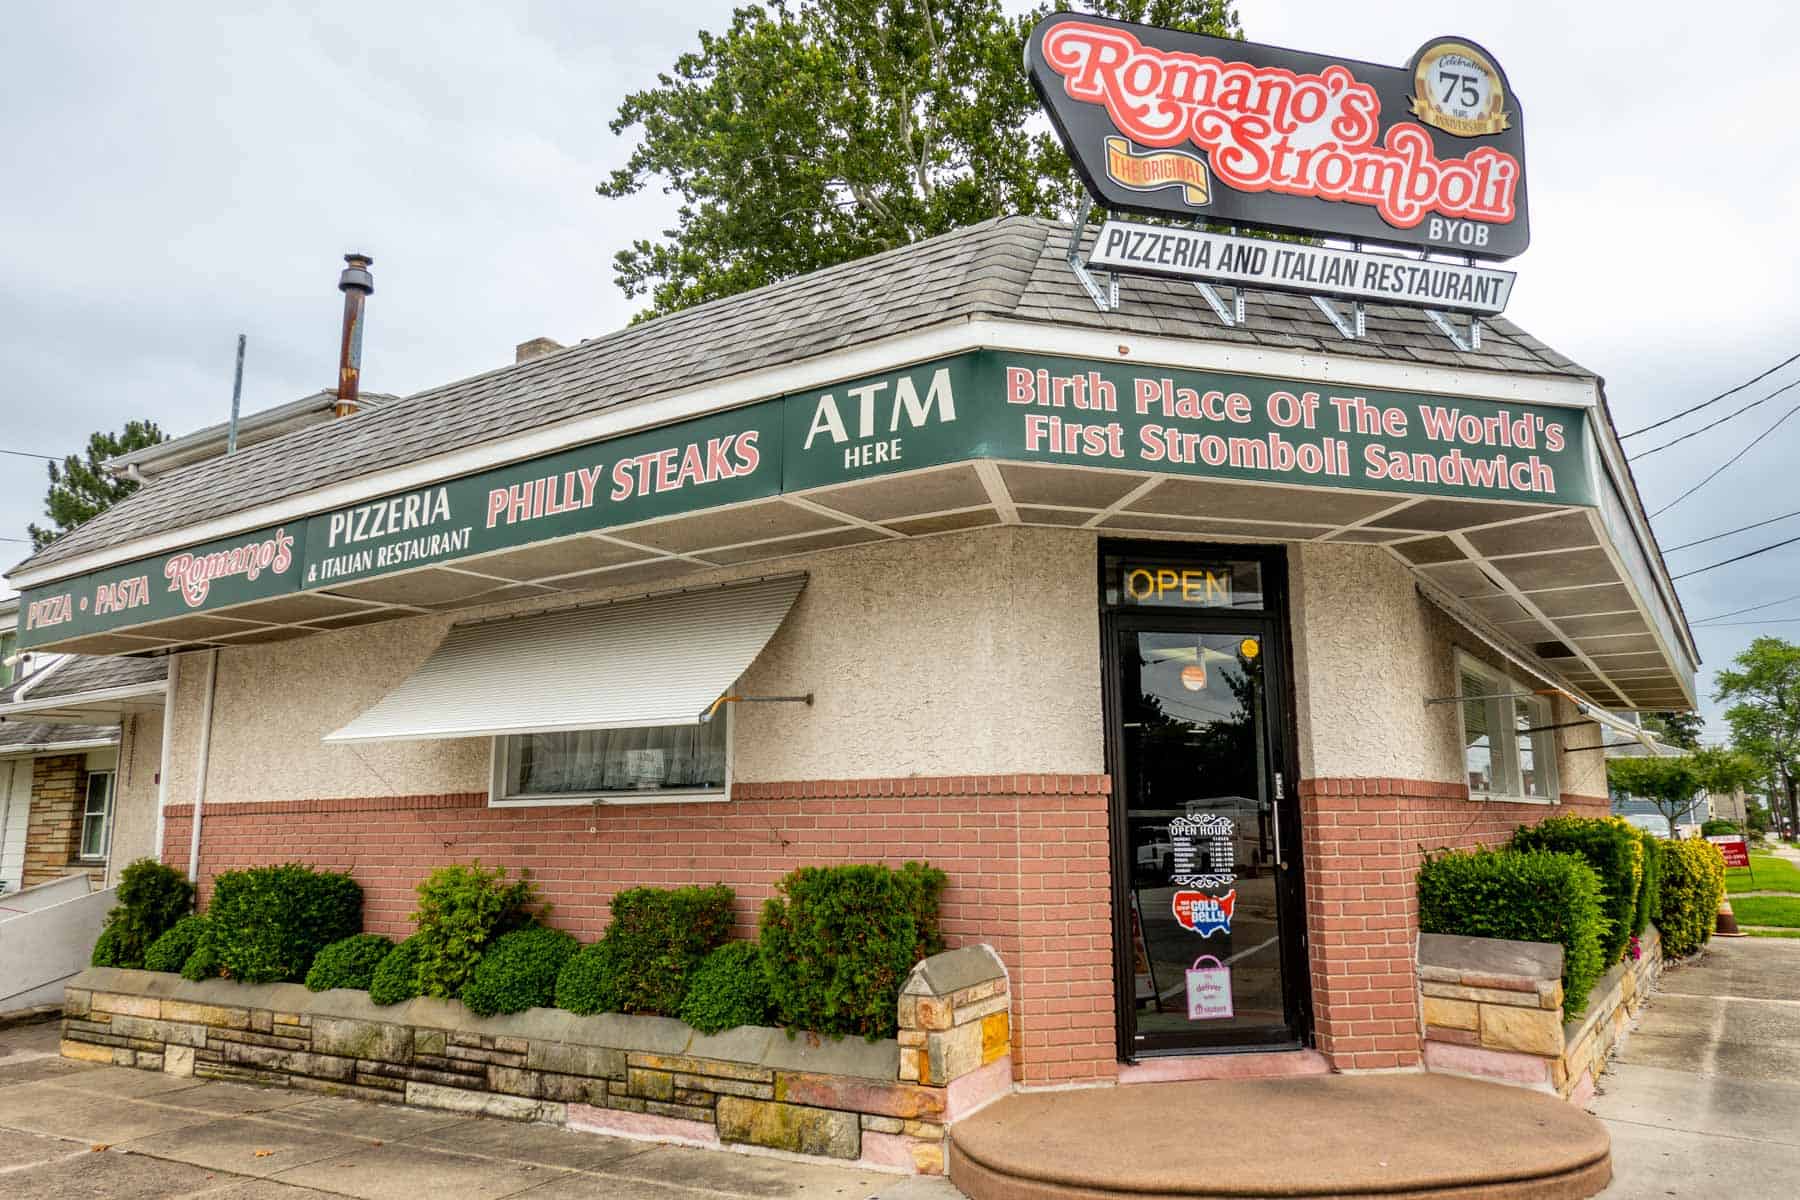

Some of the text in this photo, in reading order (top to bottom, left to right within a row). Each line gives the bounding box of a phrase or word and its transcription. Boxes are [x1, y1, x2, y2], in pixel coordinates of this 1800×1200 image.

[1046, 28, 1376, 140] Romano's
[1439, 71, 1480, 108] 75
[1111, 152, 1205, 187] THE ORIGINAL
[1198, 114, 1516, 223] Stromboli
[1429, 218, 1489, 246] BYOB
[1105, 228, 1504, 305] PIZZERIA AND ITALIAN RESTAURANT
[803, 368, 956, 450] ATM
[1005, 366, 1566, 453] Birth Place Of The World's
[486, 430, 760, 529] PHILLY STEAKS
[844, 438, 902, 470] HERE
[1023, 414, 1557, 494] First Stromboli Sandwich
[329, 487, 451, 548] PIZZERIA
[164, 527, 294, 608] Romano's
[308, 527, 473, 583] & ITALIAN RESTAURANT
[26, 575, 150, 631] PIZZA PASTA
[1127, 568, 1230, 601] OPEN
[1171, 825, 1233, 837] OPEN HOURS
[1190, 900, 1219, 911] GOLD
